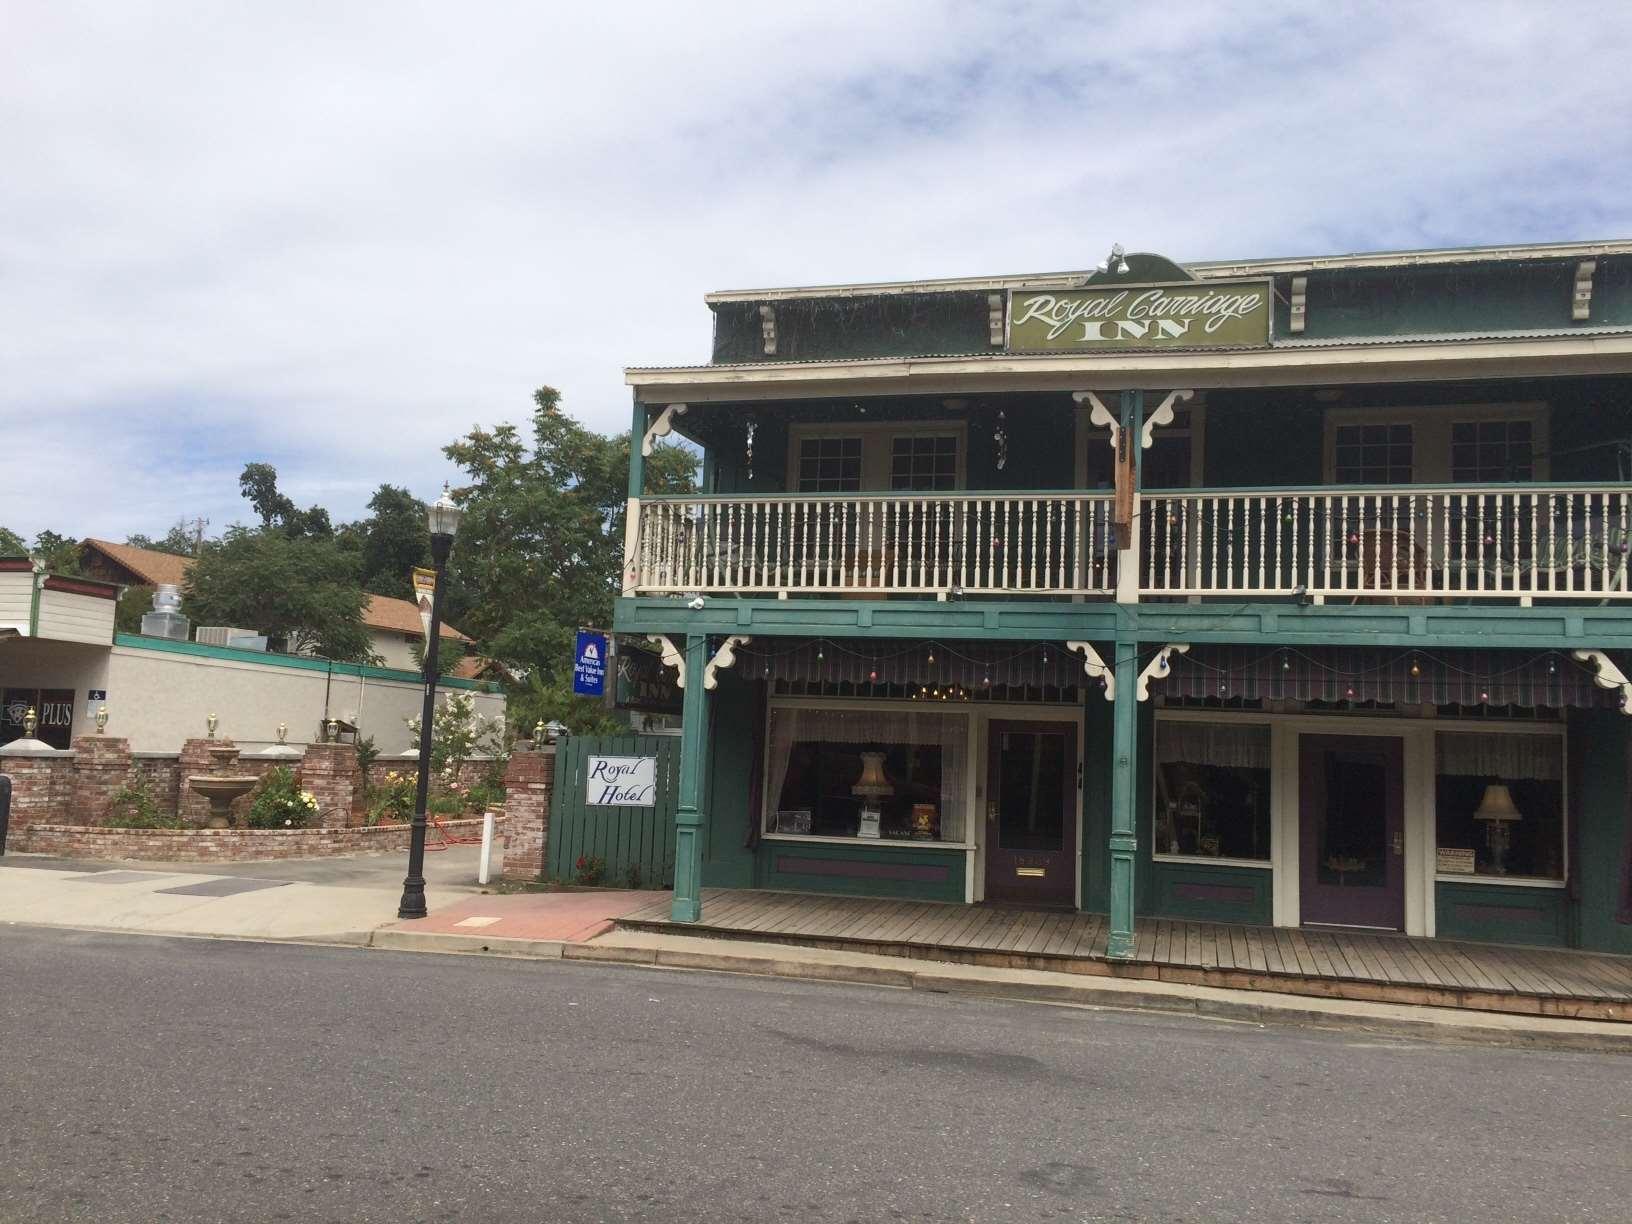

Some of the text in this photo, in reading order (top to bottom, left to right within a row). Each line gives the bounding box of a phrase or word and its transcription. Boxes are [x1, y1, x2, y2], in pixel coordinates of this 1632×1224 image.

[1013, 289, 1264, 340] Royal Carriage
[1072, 318, 1197, 342] INN
[575, 664, 585, 673] Best
[585, 666, 597, 675] Value
[585, 674, 598, 684] Suites
[41, 703, 72, 725] PLUS
[590, 759, 646, 783] Royal
[596, 785, 654, 804] Hotel
